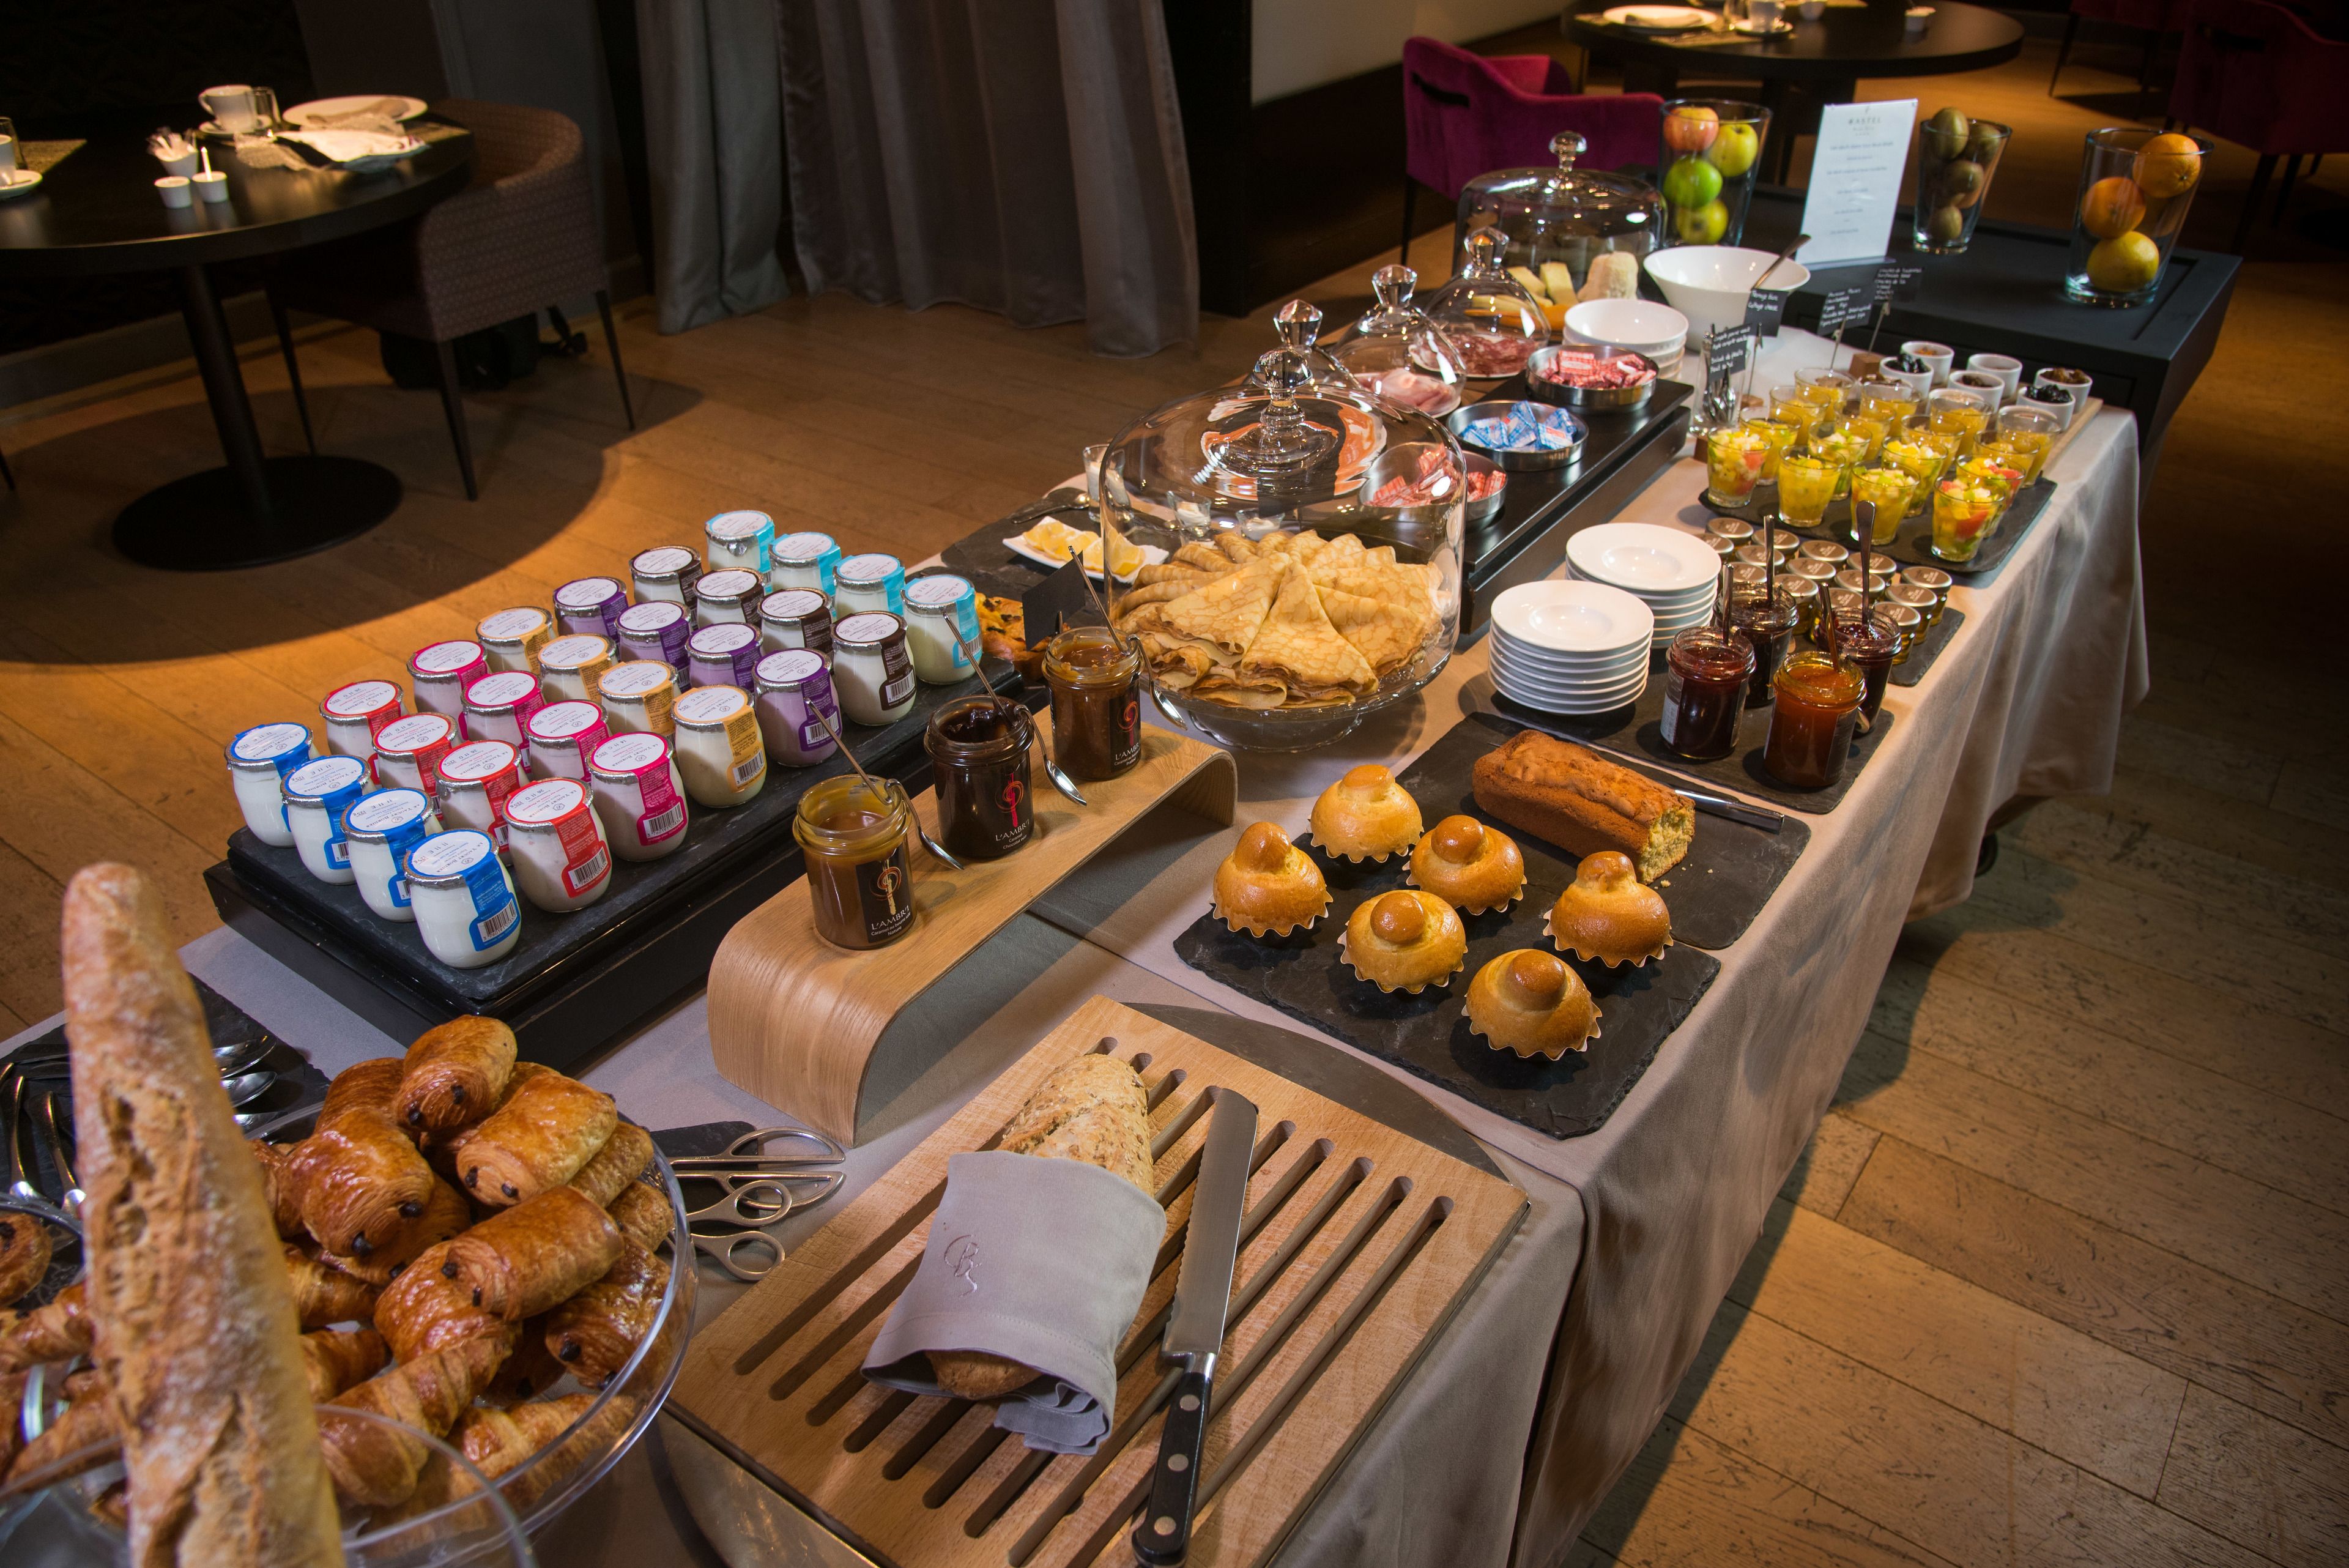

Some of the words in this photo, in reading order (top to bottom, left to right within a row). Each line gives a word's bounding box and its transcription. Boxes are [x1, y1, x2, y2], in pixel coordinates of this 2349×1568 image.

[551, 794, 570, 804] YAOURT
[1009, 832, 1023, 842] Caramel
[1003, 839, 1020, 849] Chocolat
[871, 927, 888, 936] Caramel
[895, 917, 905, 927] beurre
[888, 926, 902, 936] Nature
